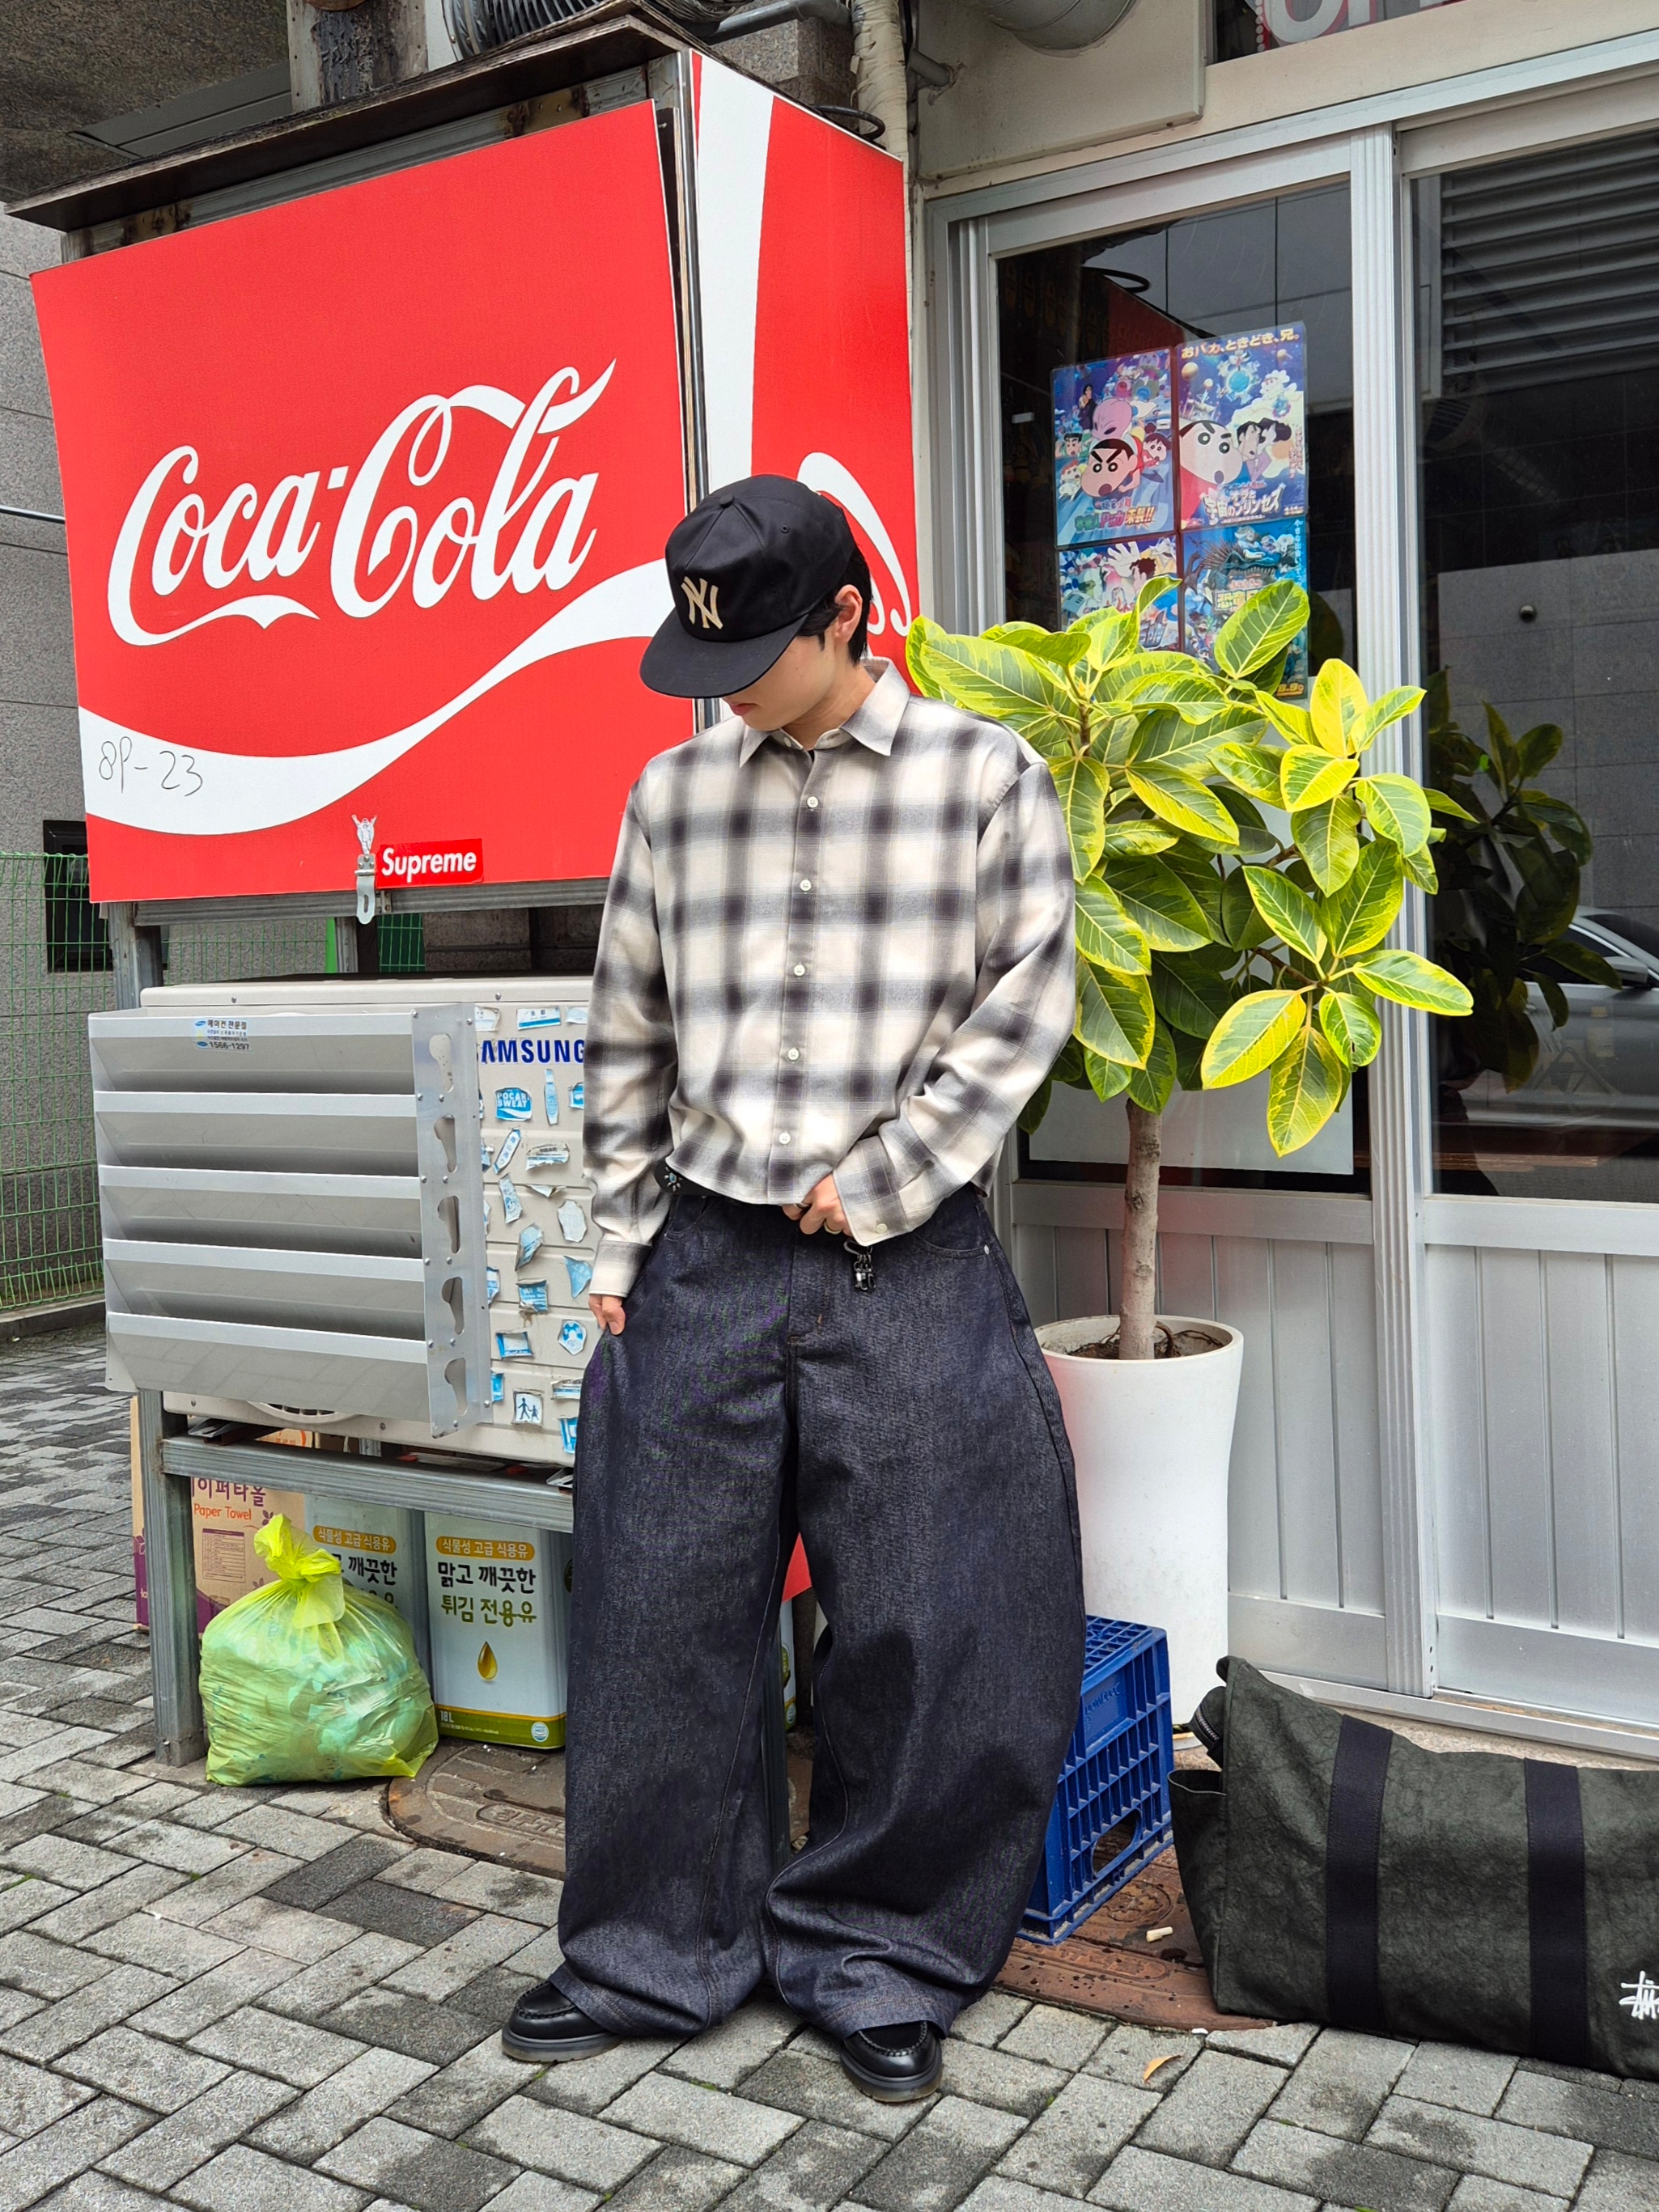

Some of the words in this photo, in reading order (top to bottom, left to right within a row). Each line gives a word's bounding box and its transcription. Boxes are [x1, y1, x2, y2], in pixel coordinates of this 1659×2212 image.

[108, 357, 617, 646] Coca-Cola
[681, 575, 723, 629] NY
[381, 847, 477, 884] Supreme
[481, 1039, 585, 1064] AMSUNG
[191, 1477, 266, 1507] 이퍼타올
[194, 1503, 223, 1519] Paper
[225, 1506, 252, 1521] Towel
[318, 1528, 342, 1545] 식물성
[345, 1532, 362, 1548] 고급
[363, 1535, 391, 1552] 식용유
[443, 1538, 471, 1554] 식물성
[474, 1541, 494, 1557] 고급
[497, 1542, 528, 1558] 식용유
[348, 1556, 397, 1586] 깨끗한
[438, 1562, 473, 1588] 맑고
[478, 1566, 537, 1594] 깨끗한
[441, 1595, 473, 1623] 튀김
[481, 1599, 537, 1628] 전용유
